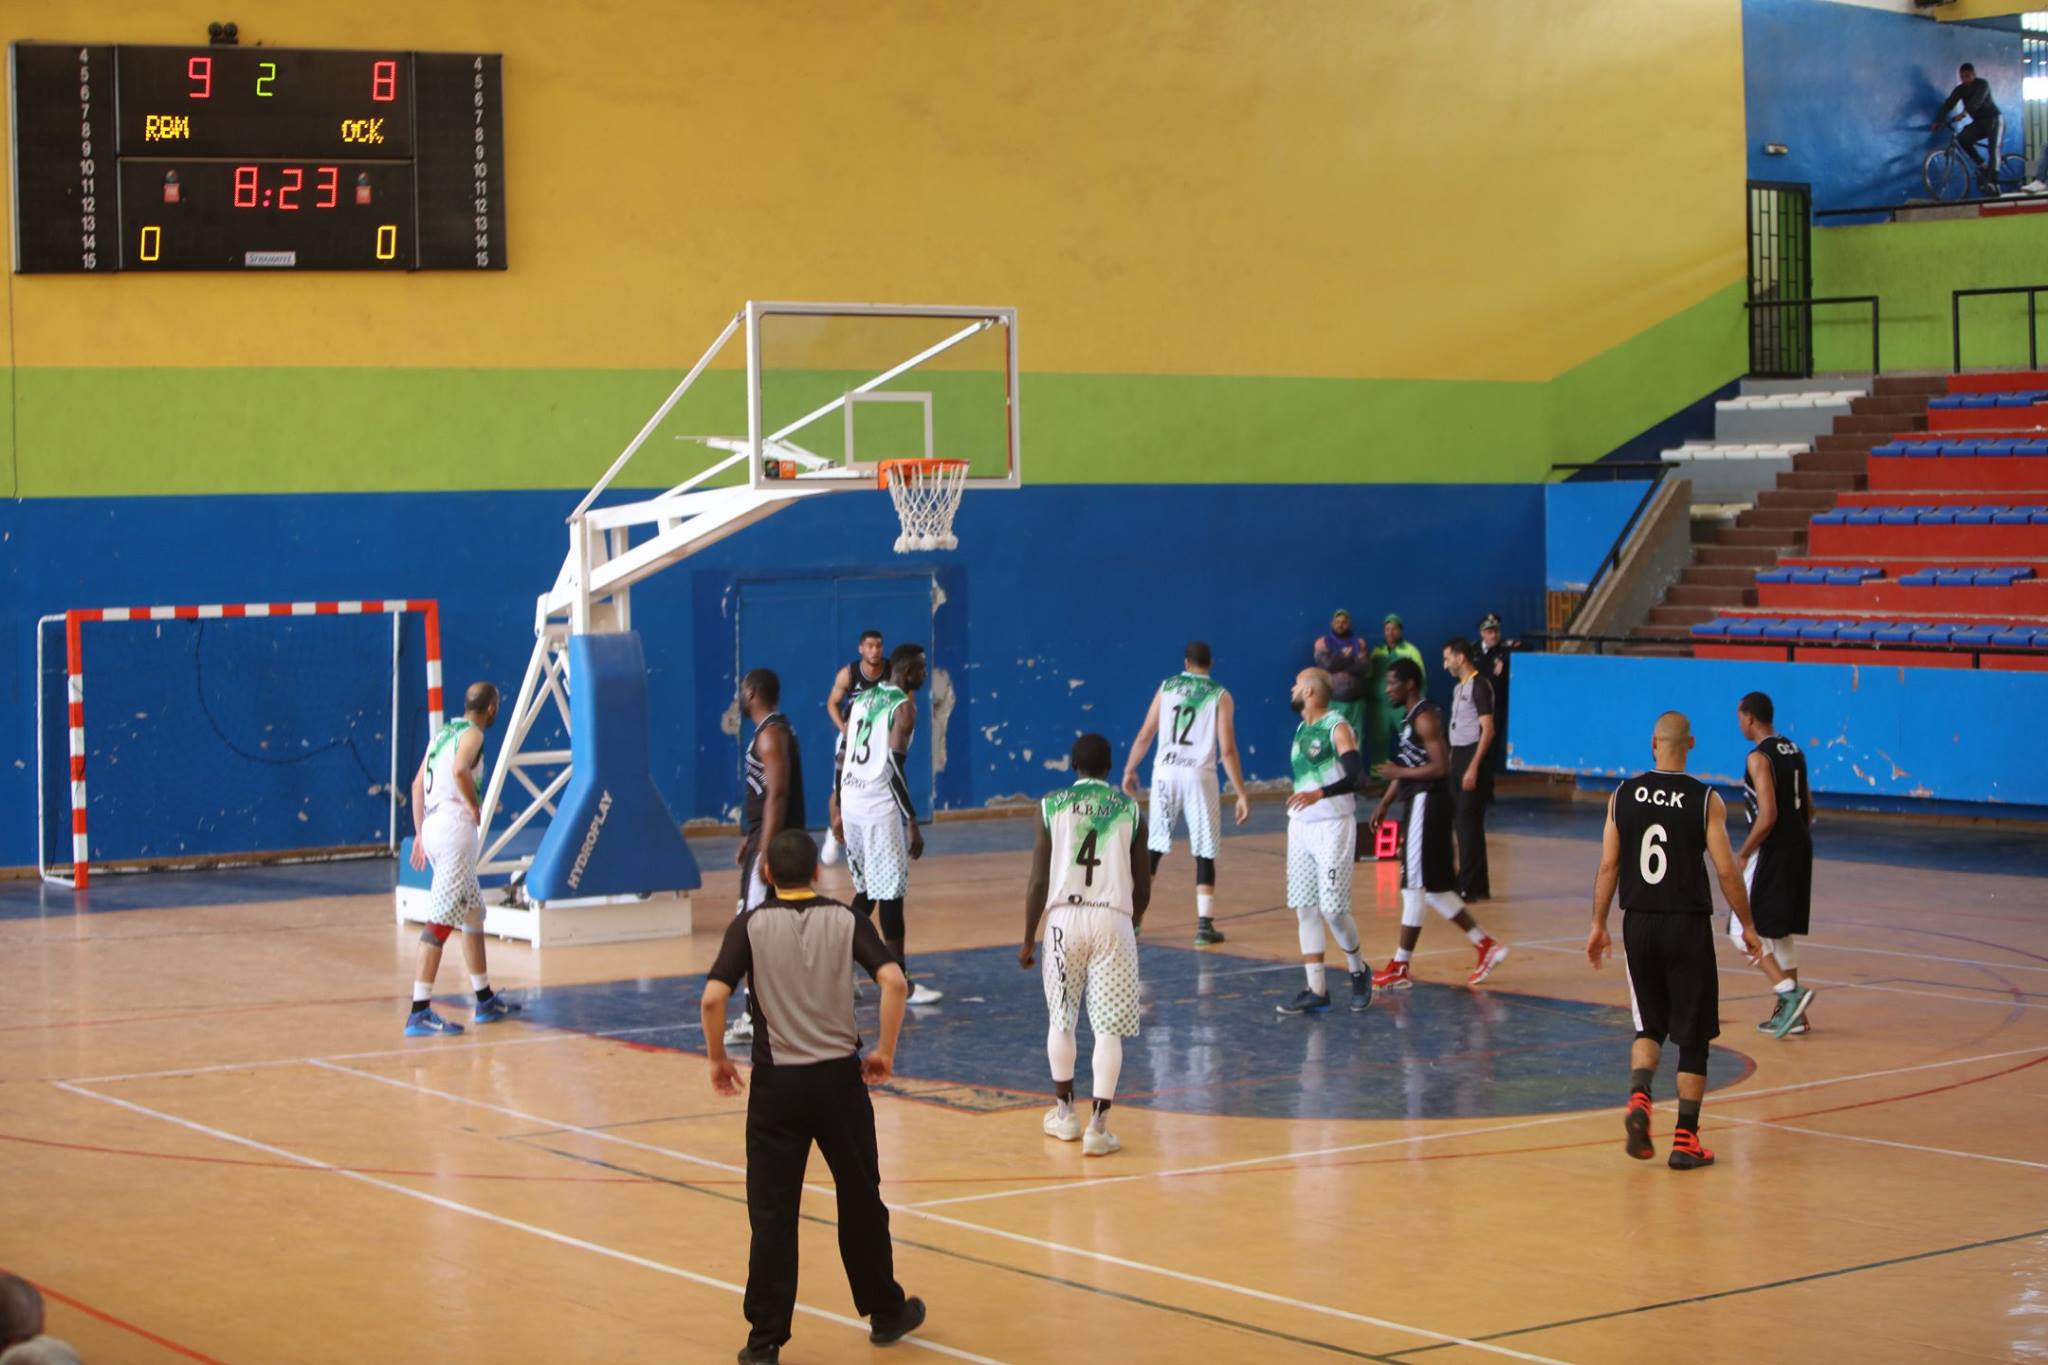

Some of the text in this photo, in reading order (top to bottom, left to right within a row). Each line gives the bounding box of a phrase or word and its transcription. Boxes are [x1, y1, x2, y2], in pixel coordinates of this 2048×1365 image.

[80, 48, 88, 63] 4
[474, 56, 482, 71] 4
[81, 67, 89, 82] 5
[189, 57, 211, 98] 9
[256, 63, 276, 96] 2
[373, 61, 396, 100] 8
[474, 74, 483, 90] 5
[81, 84, 90, 101] 6
[474, 92, 483, 107] 6
[82, 103, 90, 119] 7
[475, 109, 483, 125] 7
[82, 122, 91, 138] 8
[145, 115, 190, 141] RBM
[341, 118, 384, 143] OCK
[475, 126, 484, 142] 8
[82, 140, 91, 157] 9
[475, 144, 484, 160] 9
[80, 159, 94, 176] 10
[473, 162, 487, 178] 10
[81, 178, 94, 194] 11
[474, 180, 487, 196] 11
[81, 196, 96, 213] 12
[474, 198, 488, 213] 12
[81, 215, 96, 231] 13
[474, 215, 488, 231] 13
[81, 234, 96, 250] 14
[140, 226, 160, 261] 0
[376, 225, 396, 259] 0
[475, 233, 488, 249] 14
[82, 252, 96, 269] 15
[475, 251, 489, 267] 15
[1172, 705, 1196, 747] 12
[851, 718, 874, 766] 13
[1634, 786, 1686, 809] O.C.K
[567, 789, 614, 890] HYDROPLAY
[1375, 820, 1398, 857] 8
[1076, 828, 1102, 888] 4
[1640, 823, 1668, 885] 6
